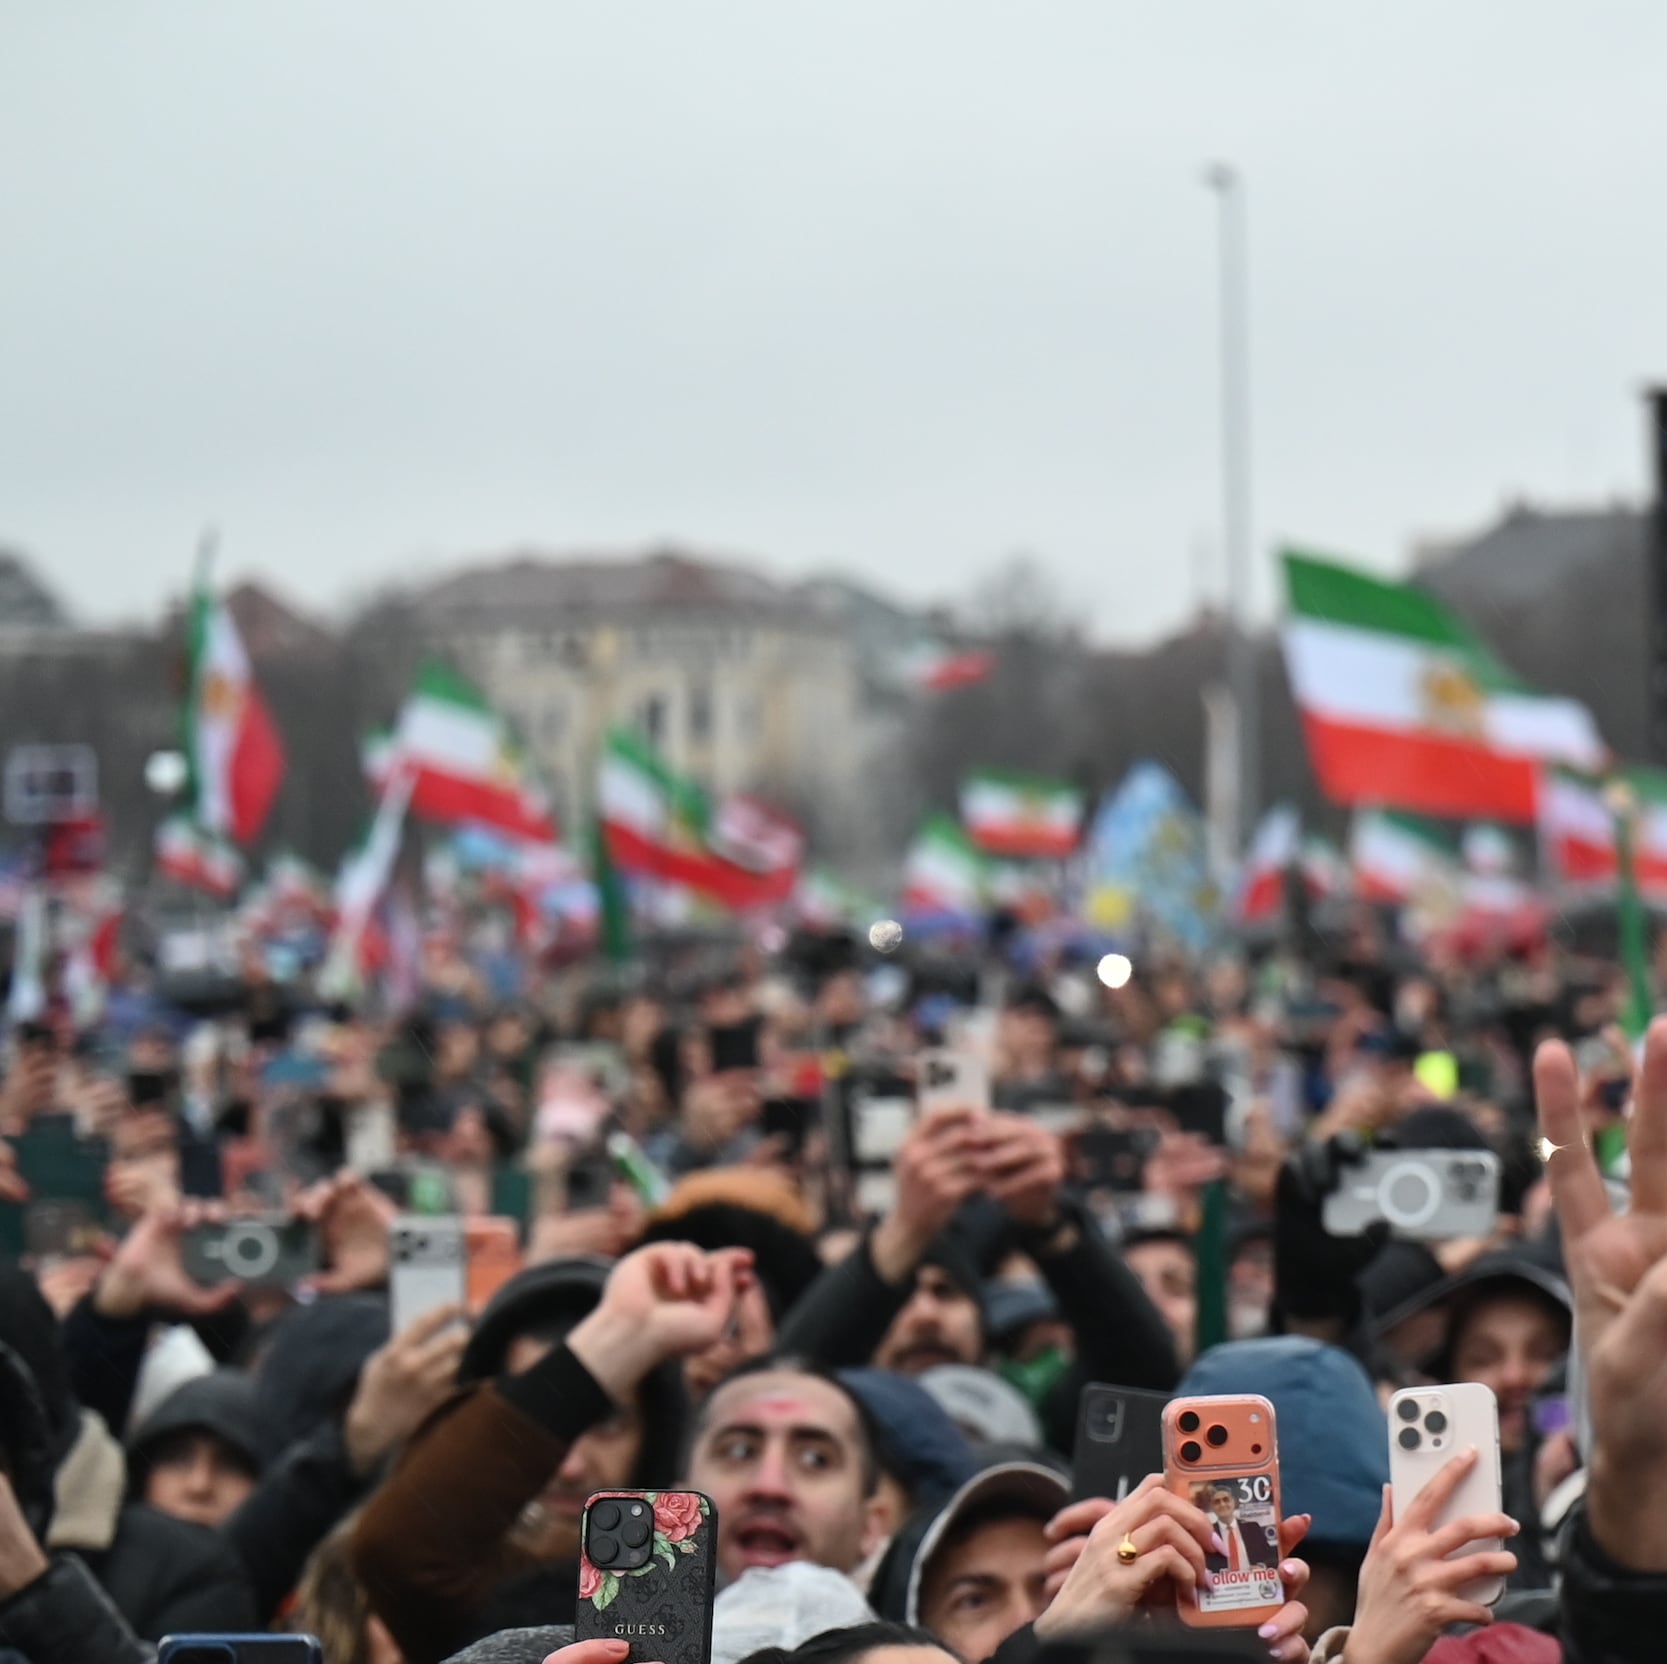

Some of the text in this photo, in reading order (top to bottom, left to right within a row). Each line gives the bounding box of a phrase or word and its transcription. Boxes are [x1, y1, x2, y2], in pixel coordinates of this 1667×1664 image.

[1212, 1569, 1275, 1585] ollow me
[614, 1623, 665, 1635] GUESS
